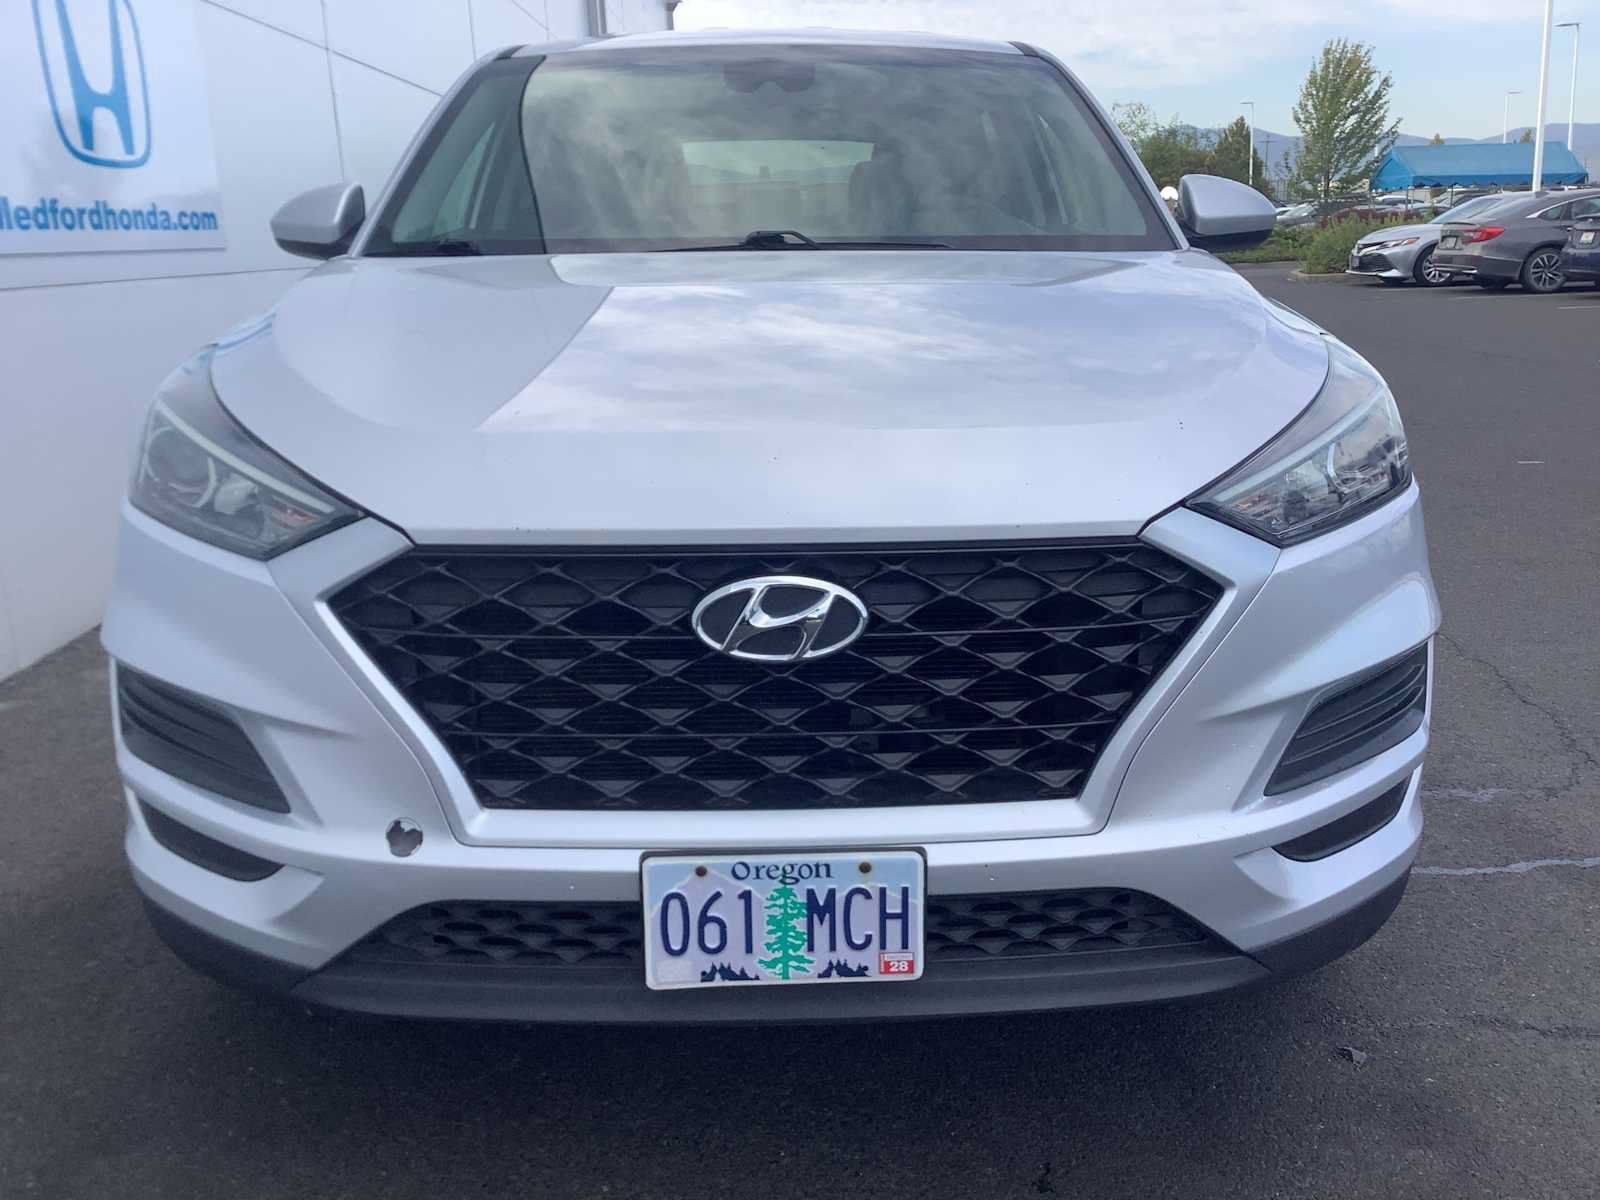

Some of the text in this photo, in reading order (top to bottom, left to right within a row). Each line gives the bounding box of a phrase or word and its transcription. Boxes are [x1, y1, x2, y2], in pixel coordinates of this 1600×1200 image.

[731, 860, 834, 885] Oregon
[660, 885, 910, 956] 061 MCH
